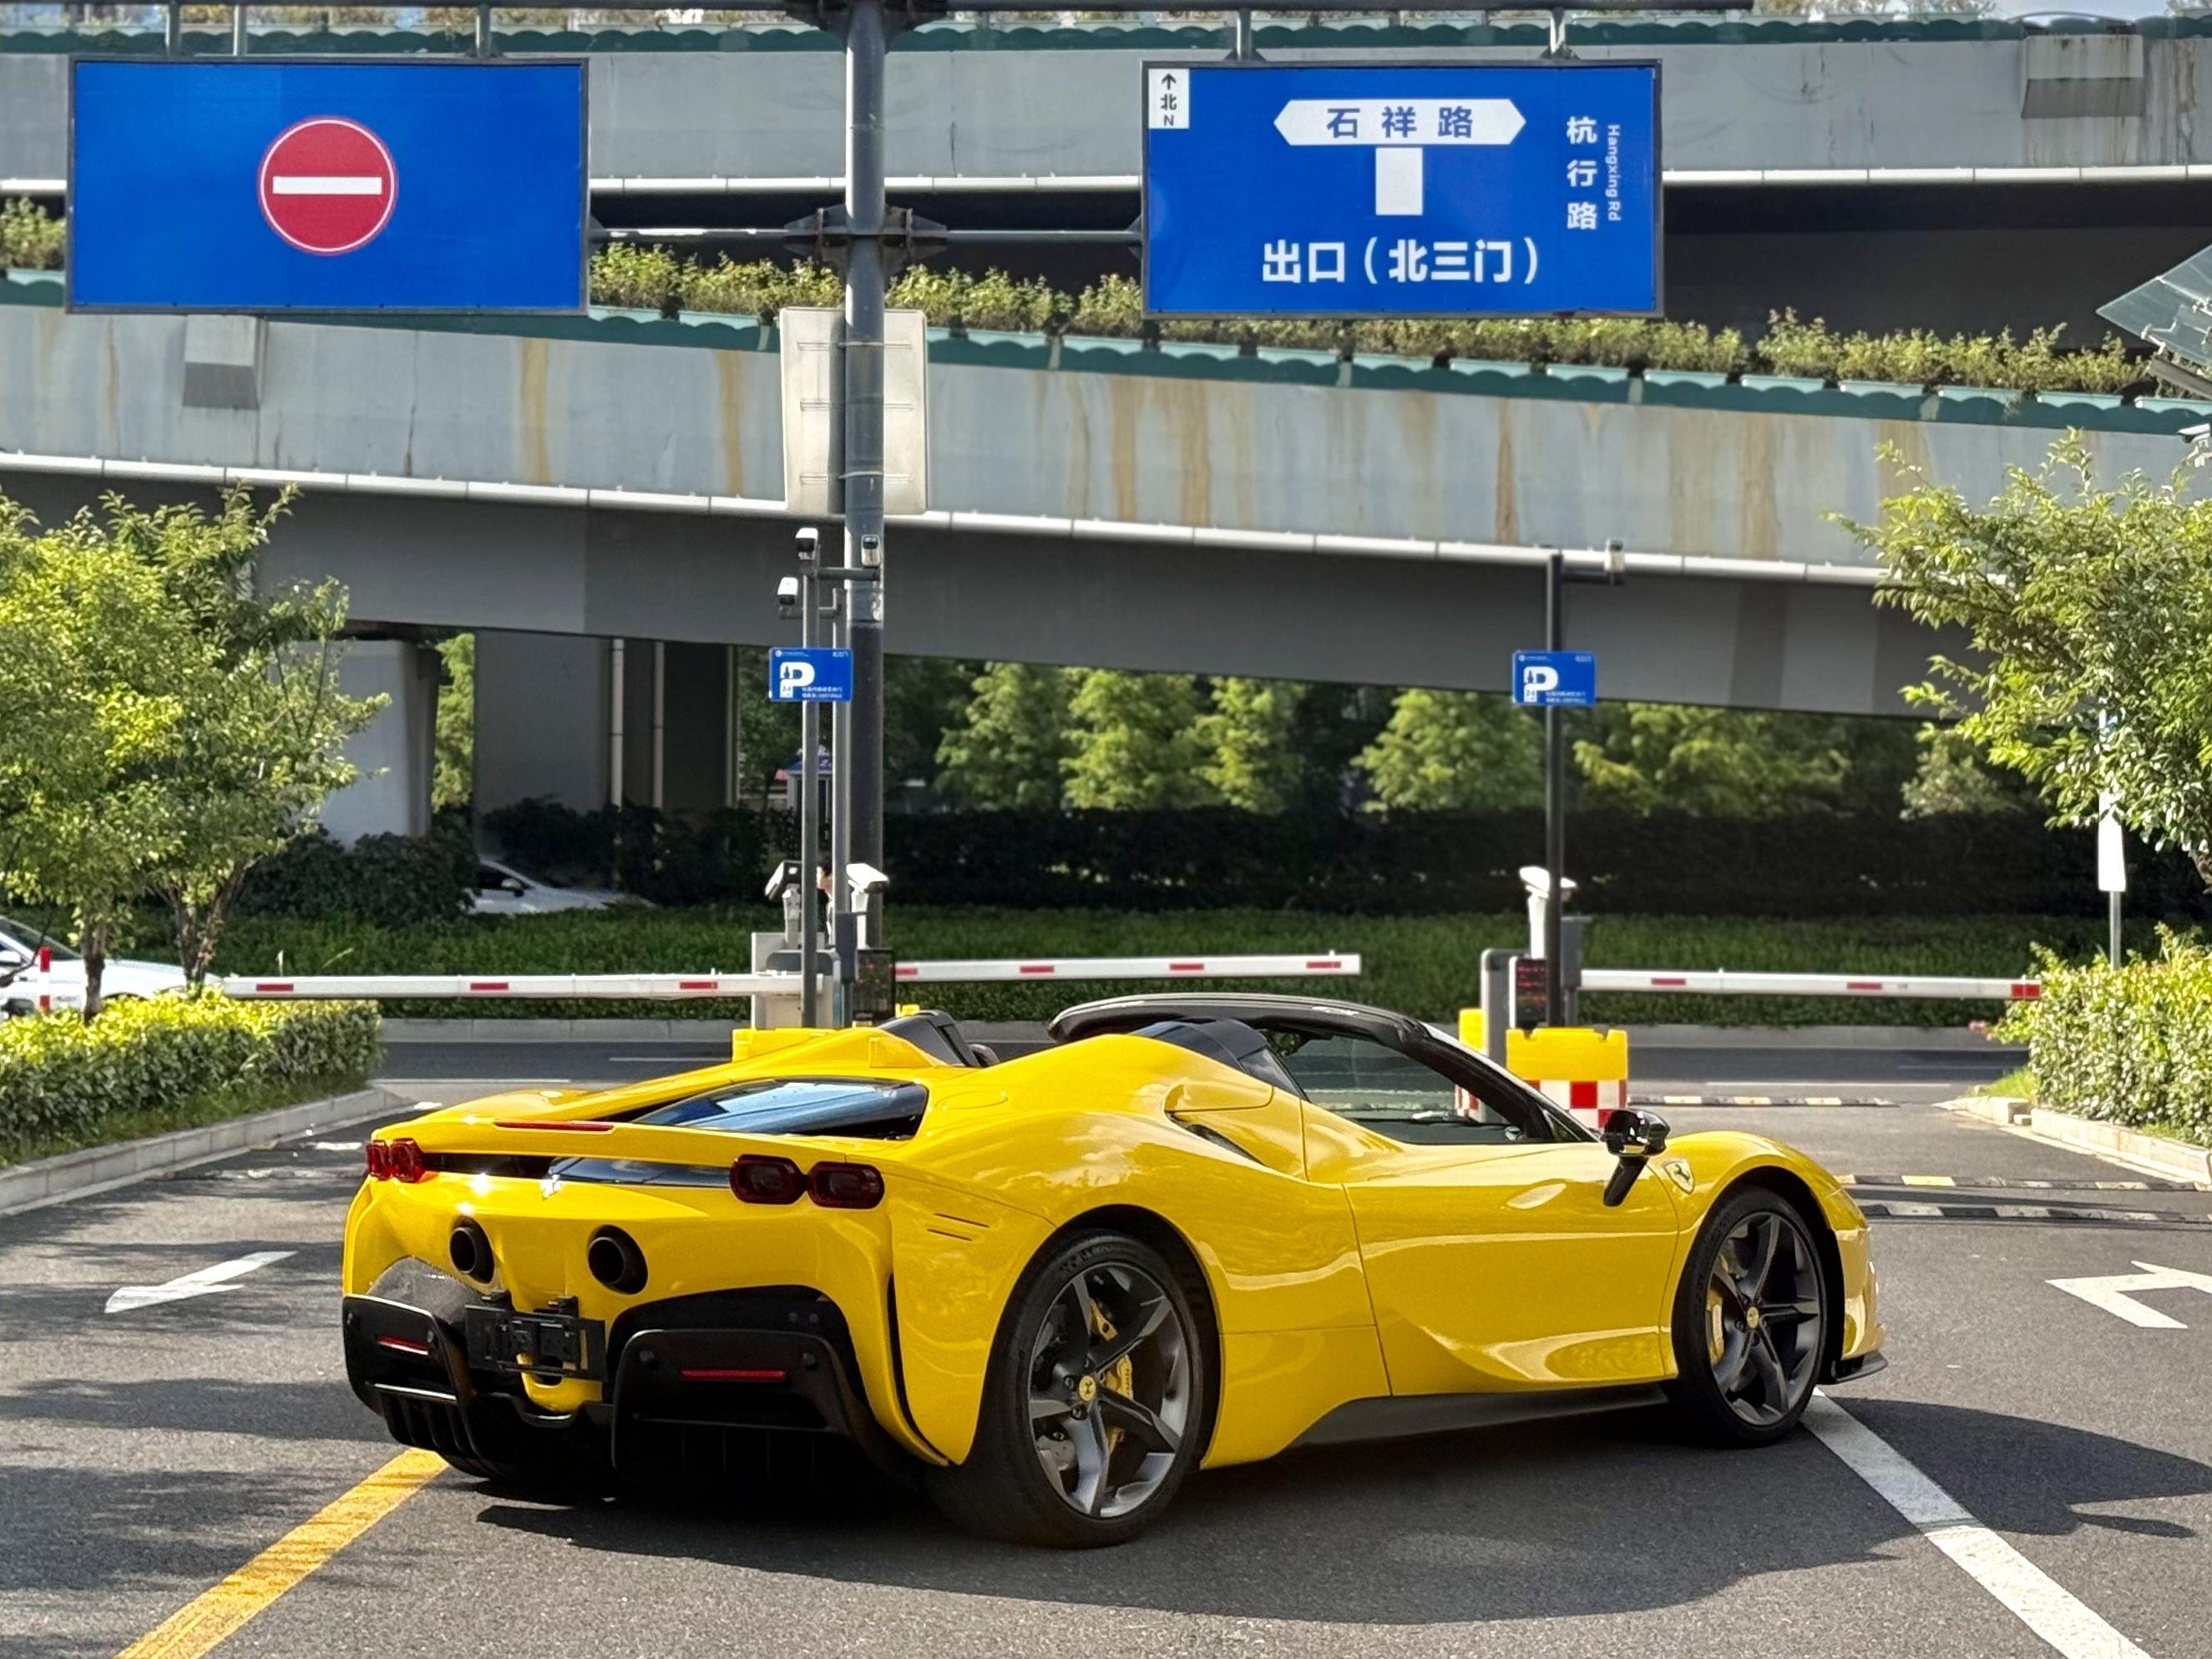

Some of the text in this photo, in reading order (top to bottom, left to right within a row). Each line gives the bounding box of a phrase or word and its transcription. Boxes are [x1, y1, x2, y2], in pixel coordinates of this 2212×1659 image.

[1161, 94, 1177, 111] 北
[1163, 114, 1174, 127] N
[1326, 105, 1473, 139] 石祥路
[1567, 116, 1597, 230] 杭行路
[1605, 124, 1621, 221] Hangxing Rd
[1263, 237, 1538, 284] 出口（北三门）
[780, 662, 815, 698] P
[1524, 666, 1558, 703] P
